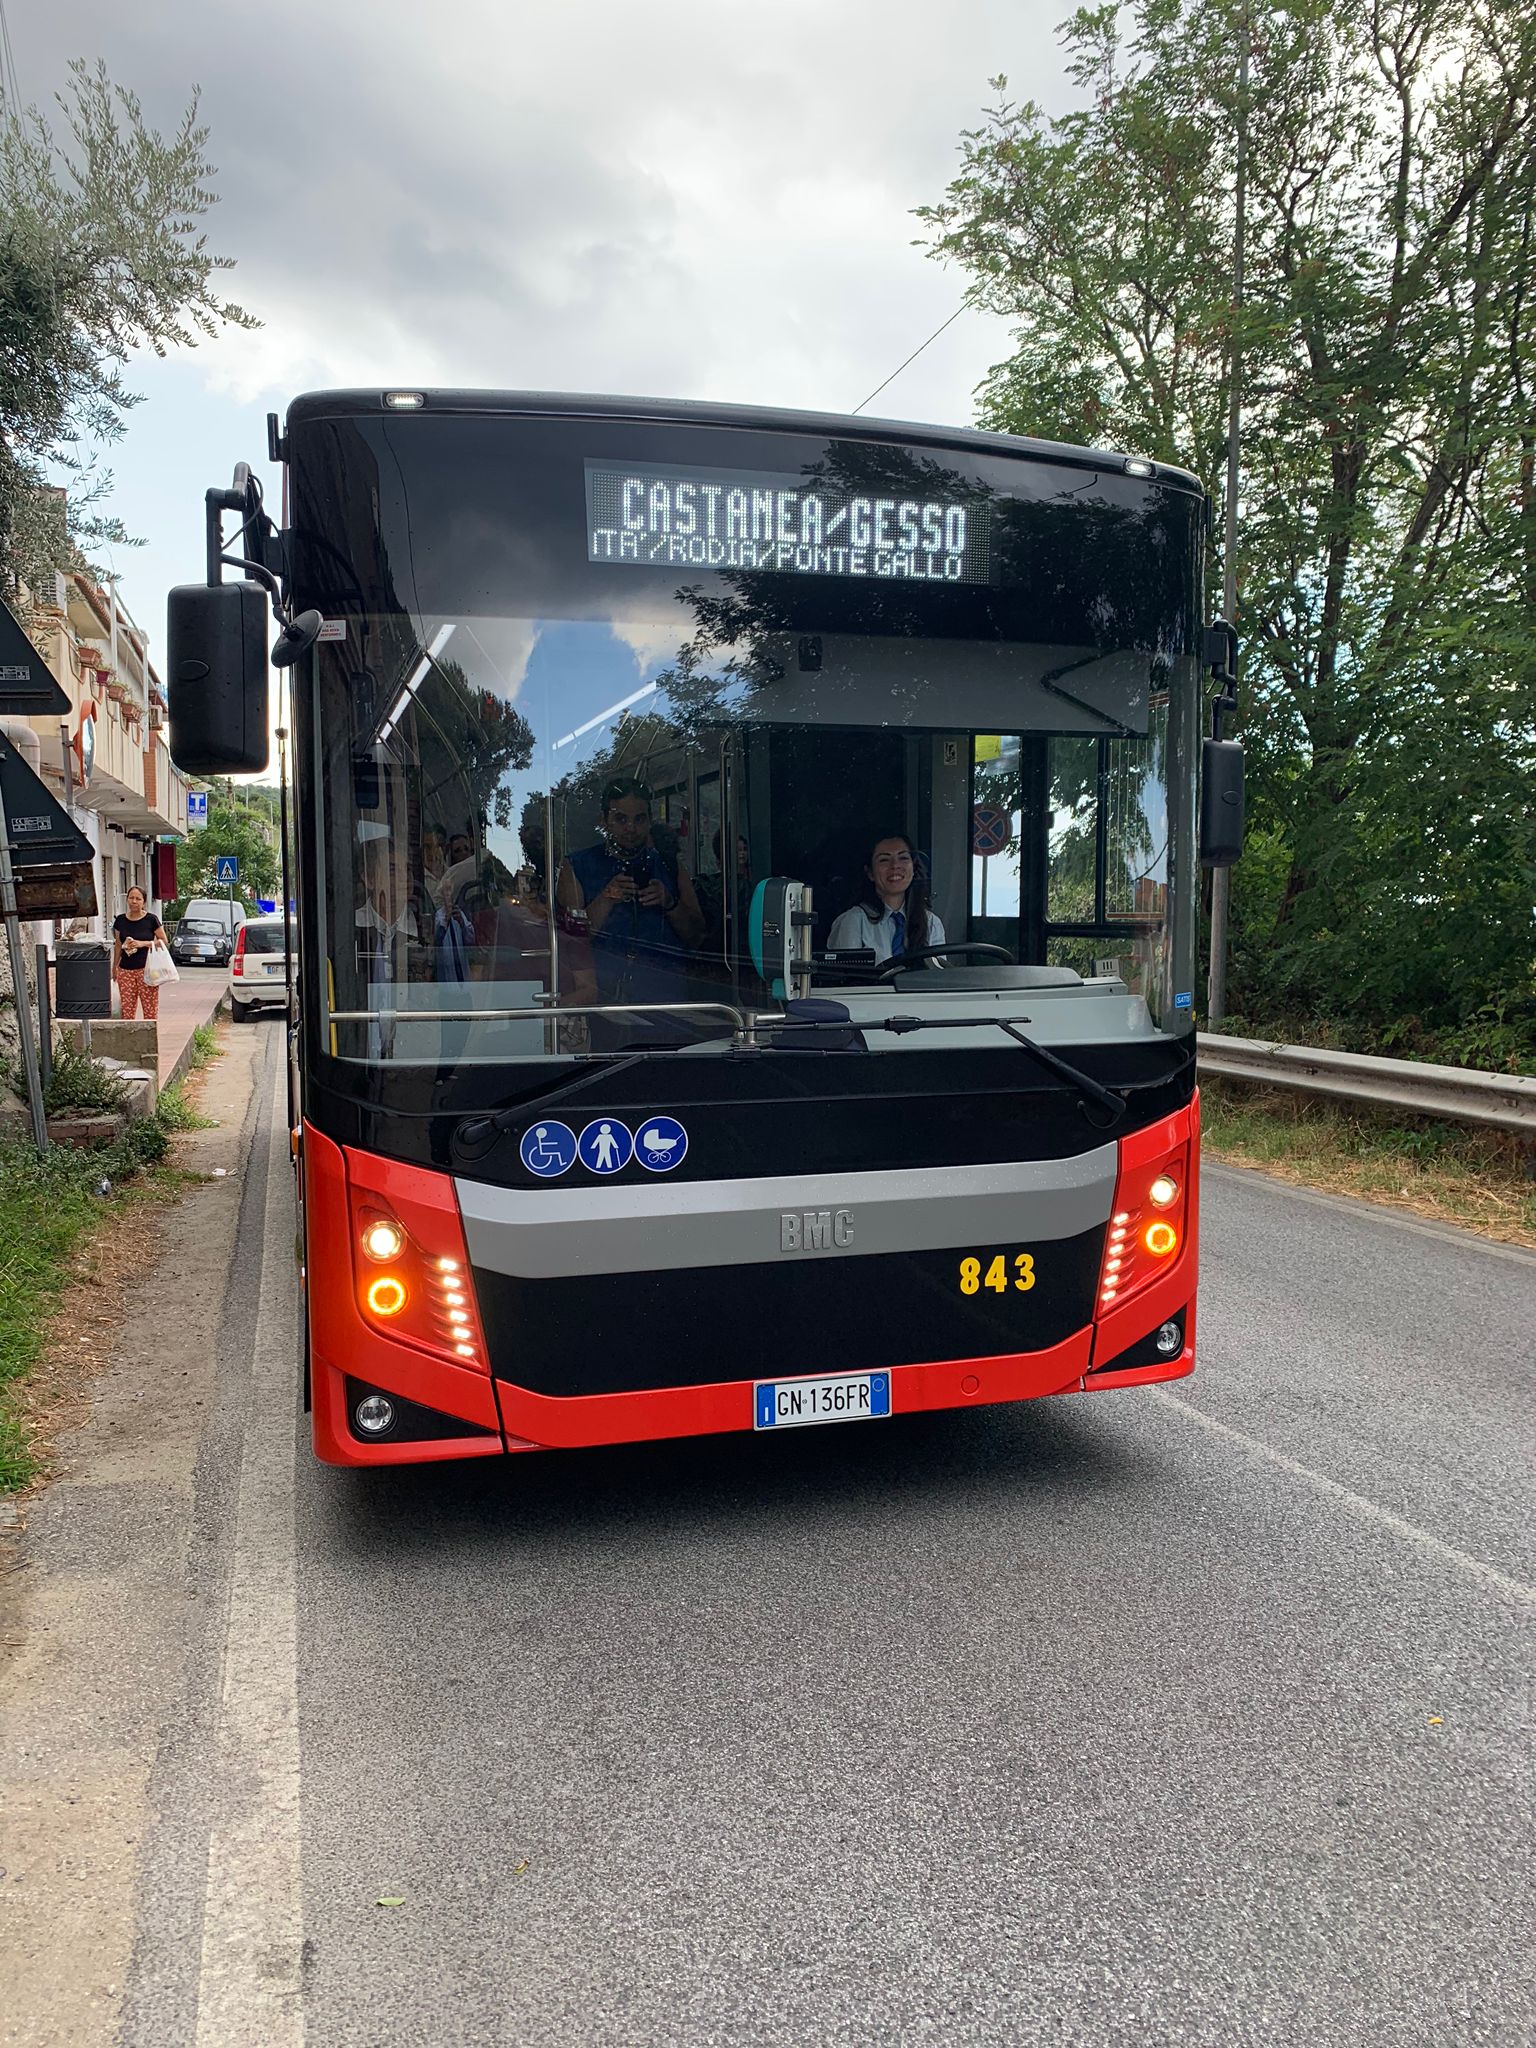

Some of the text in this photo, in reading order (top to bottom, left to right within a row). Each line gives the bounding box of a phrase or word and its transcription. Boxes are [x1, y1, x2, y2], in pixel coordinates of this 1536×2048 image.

[624, 479, 965, 553] CASTANEA/GESSO
[594, 528, 961, 579] TA'/RODIA/PONTE GALLO
[780, 1210, 855, 1252] BMC
[960, 1253, 1036, 1295] 843
